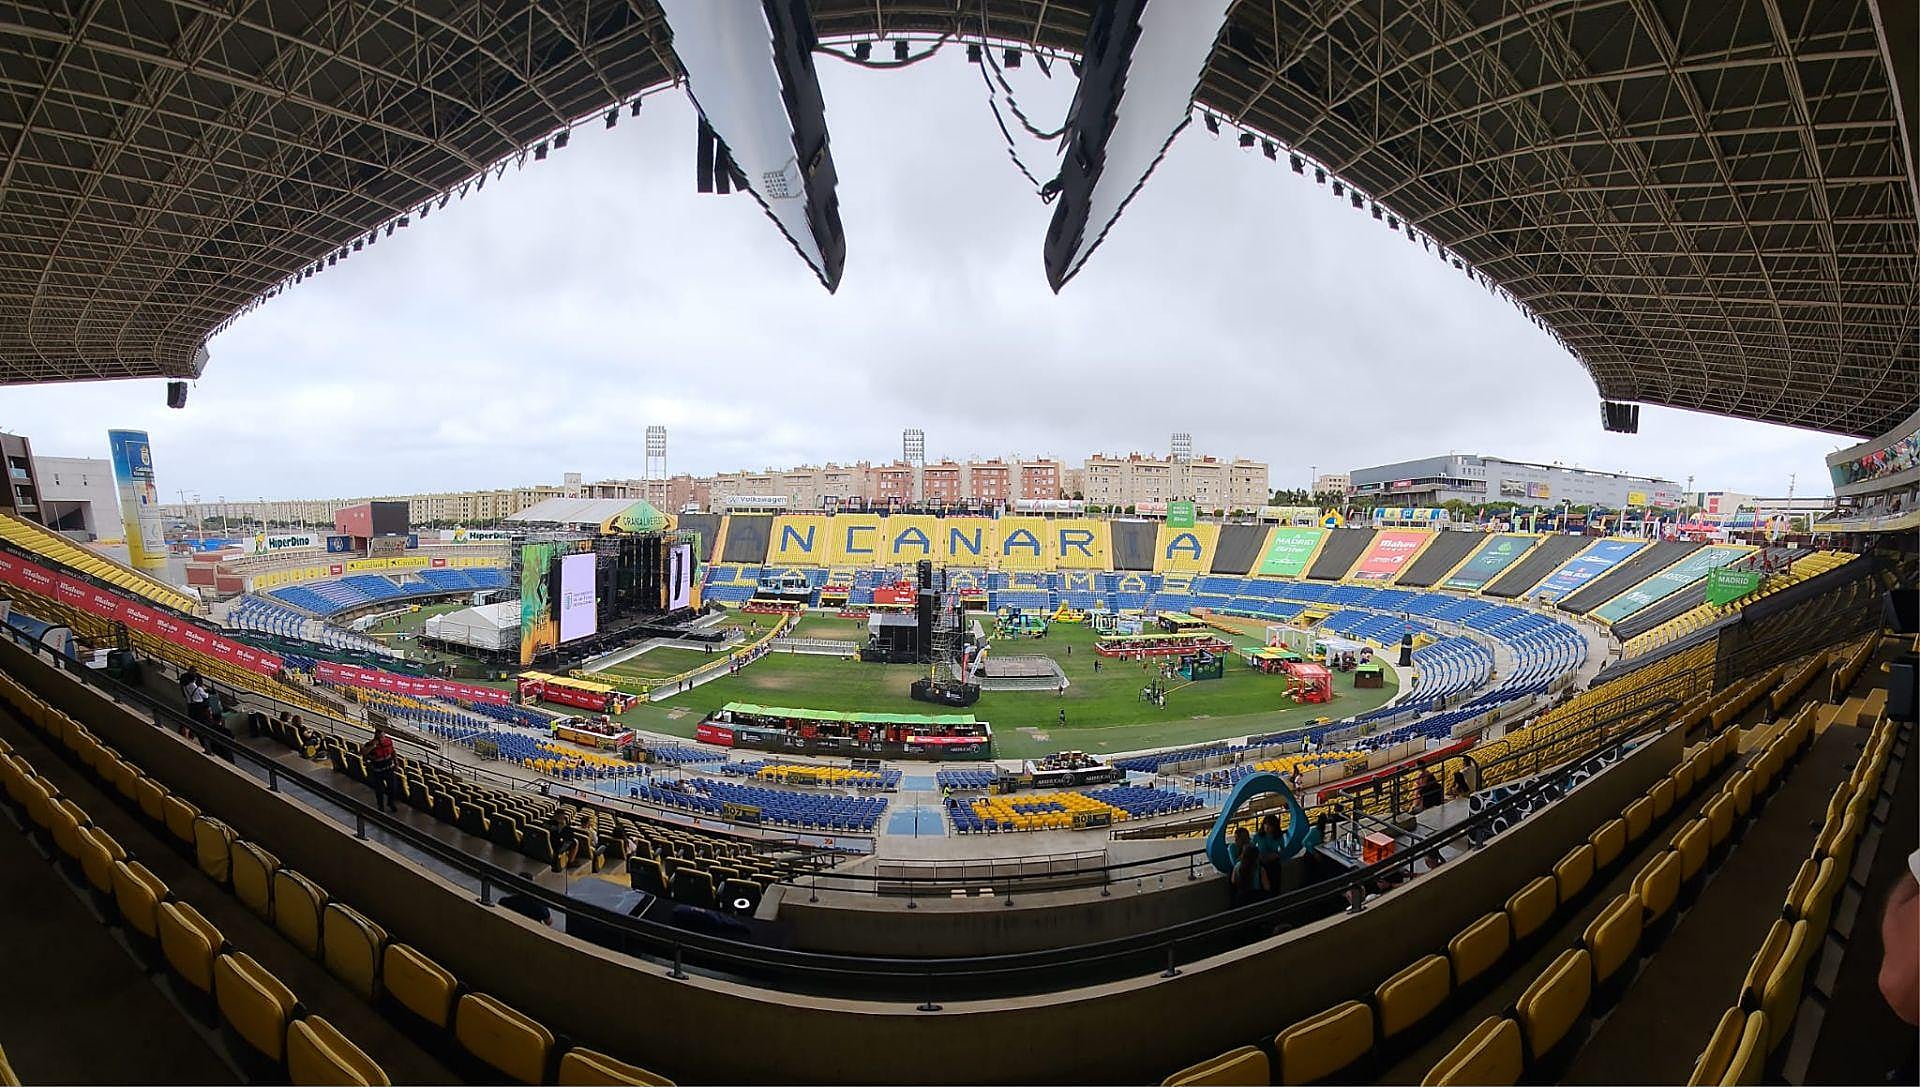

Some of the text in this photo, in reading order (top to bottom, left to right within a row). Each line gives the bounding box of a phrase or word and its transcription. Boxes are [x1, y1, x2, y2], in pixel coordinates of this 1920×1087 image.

[740, 496, 787, 504] Volkswagen
[268, 536, 310, 549] HiperDino
[847, 525, 1202, 560] CANARIA
[1719, 576, 1749, 585] MADRID
